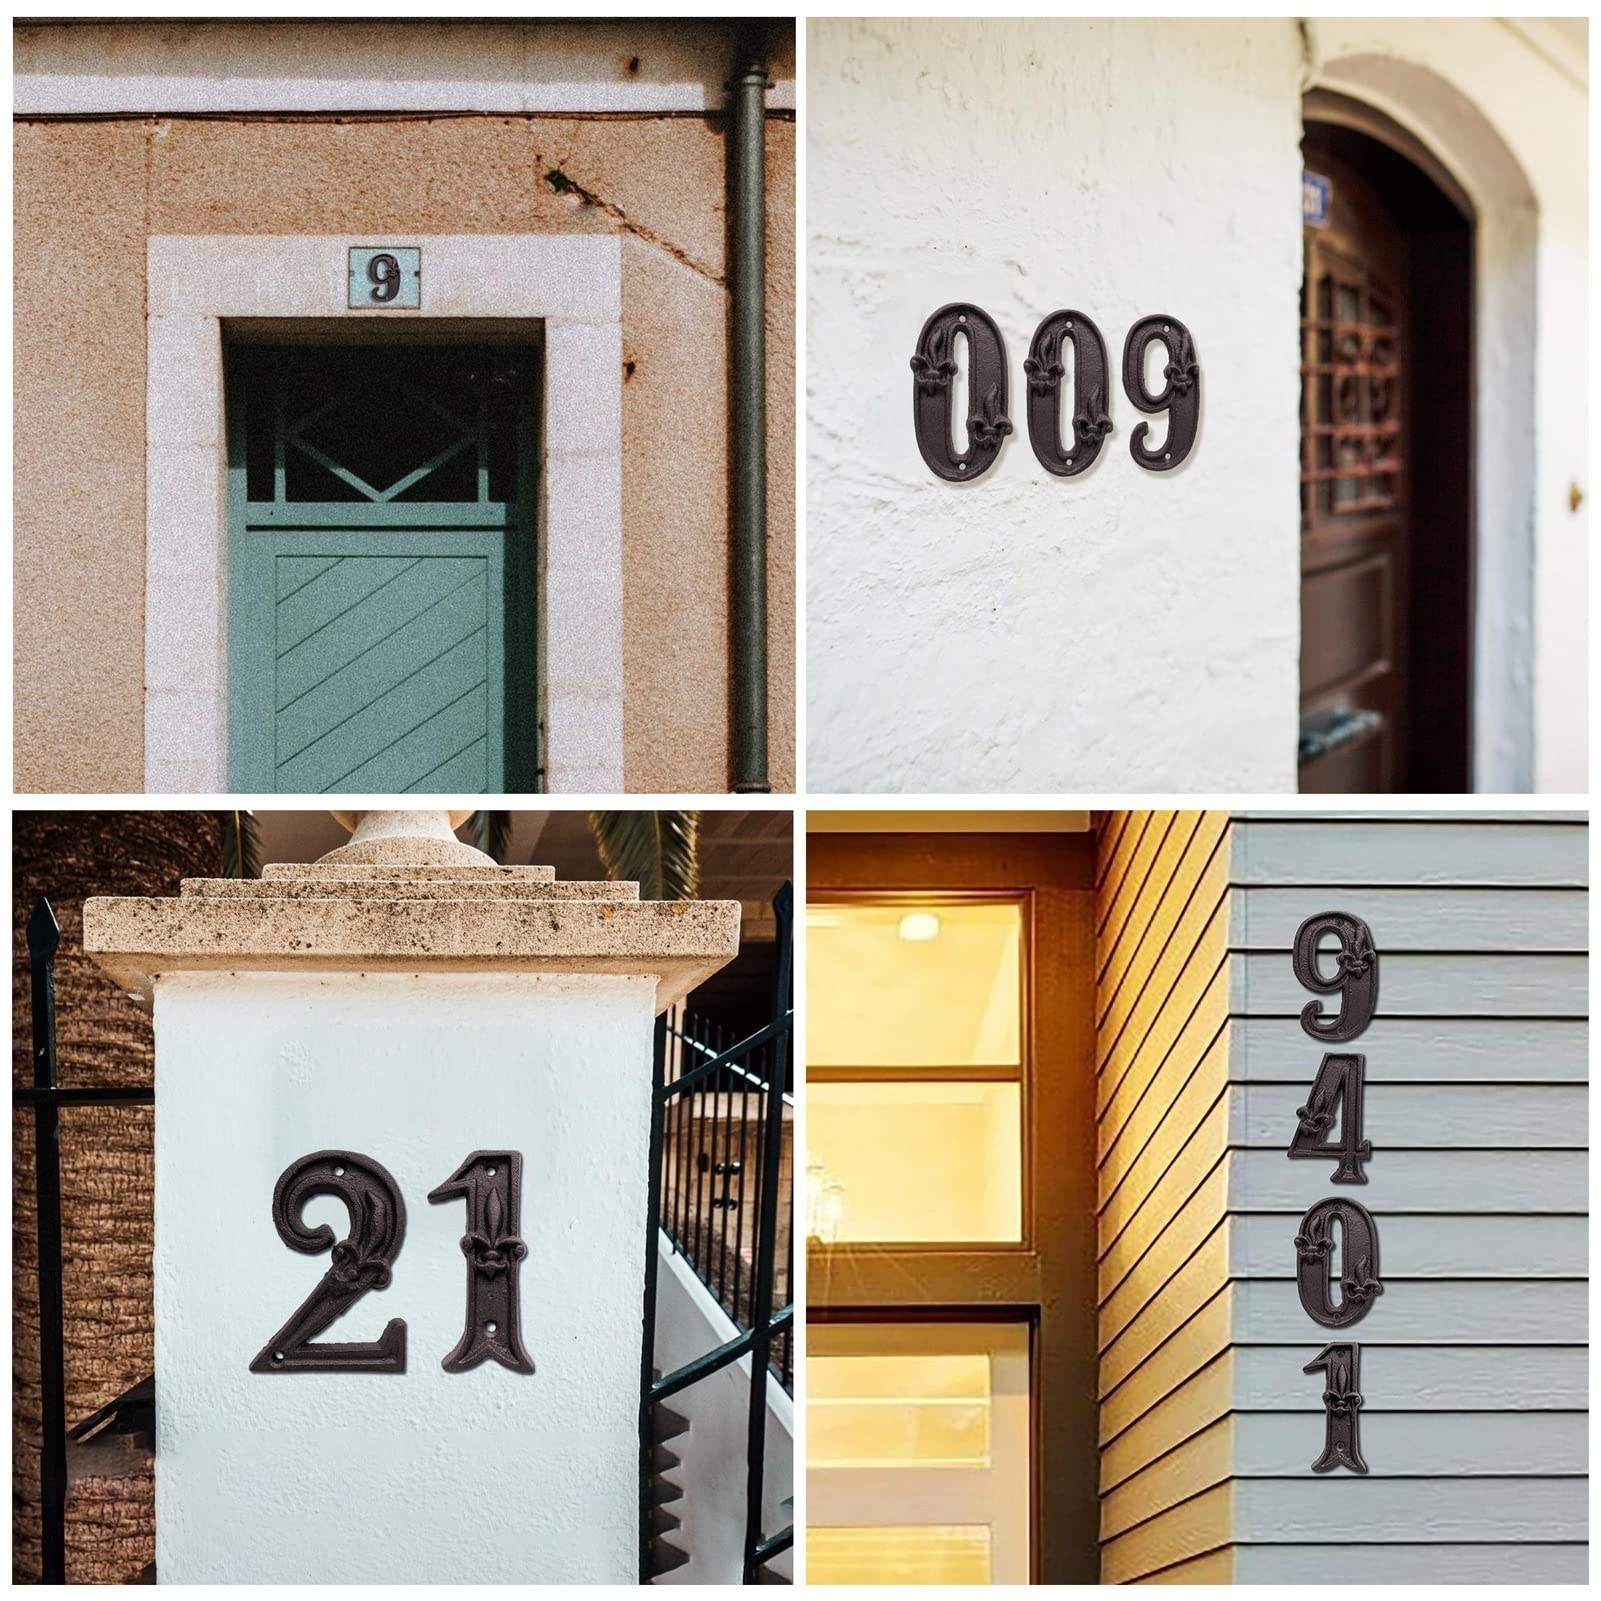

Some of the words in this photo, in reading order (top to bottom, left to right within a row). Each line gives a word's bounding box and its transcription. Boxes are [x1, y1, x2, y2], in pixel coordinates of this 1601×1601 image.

[369, 254, 400, 302] 9
[910, 303, 1203, 481] 009
[249, 1150, 535, 1375] 21
[1287, 911, 1383, 1474] 9401
